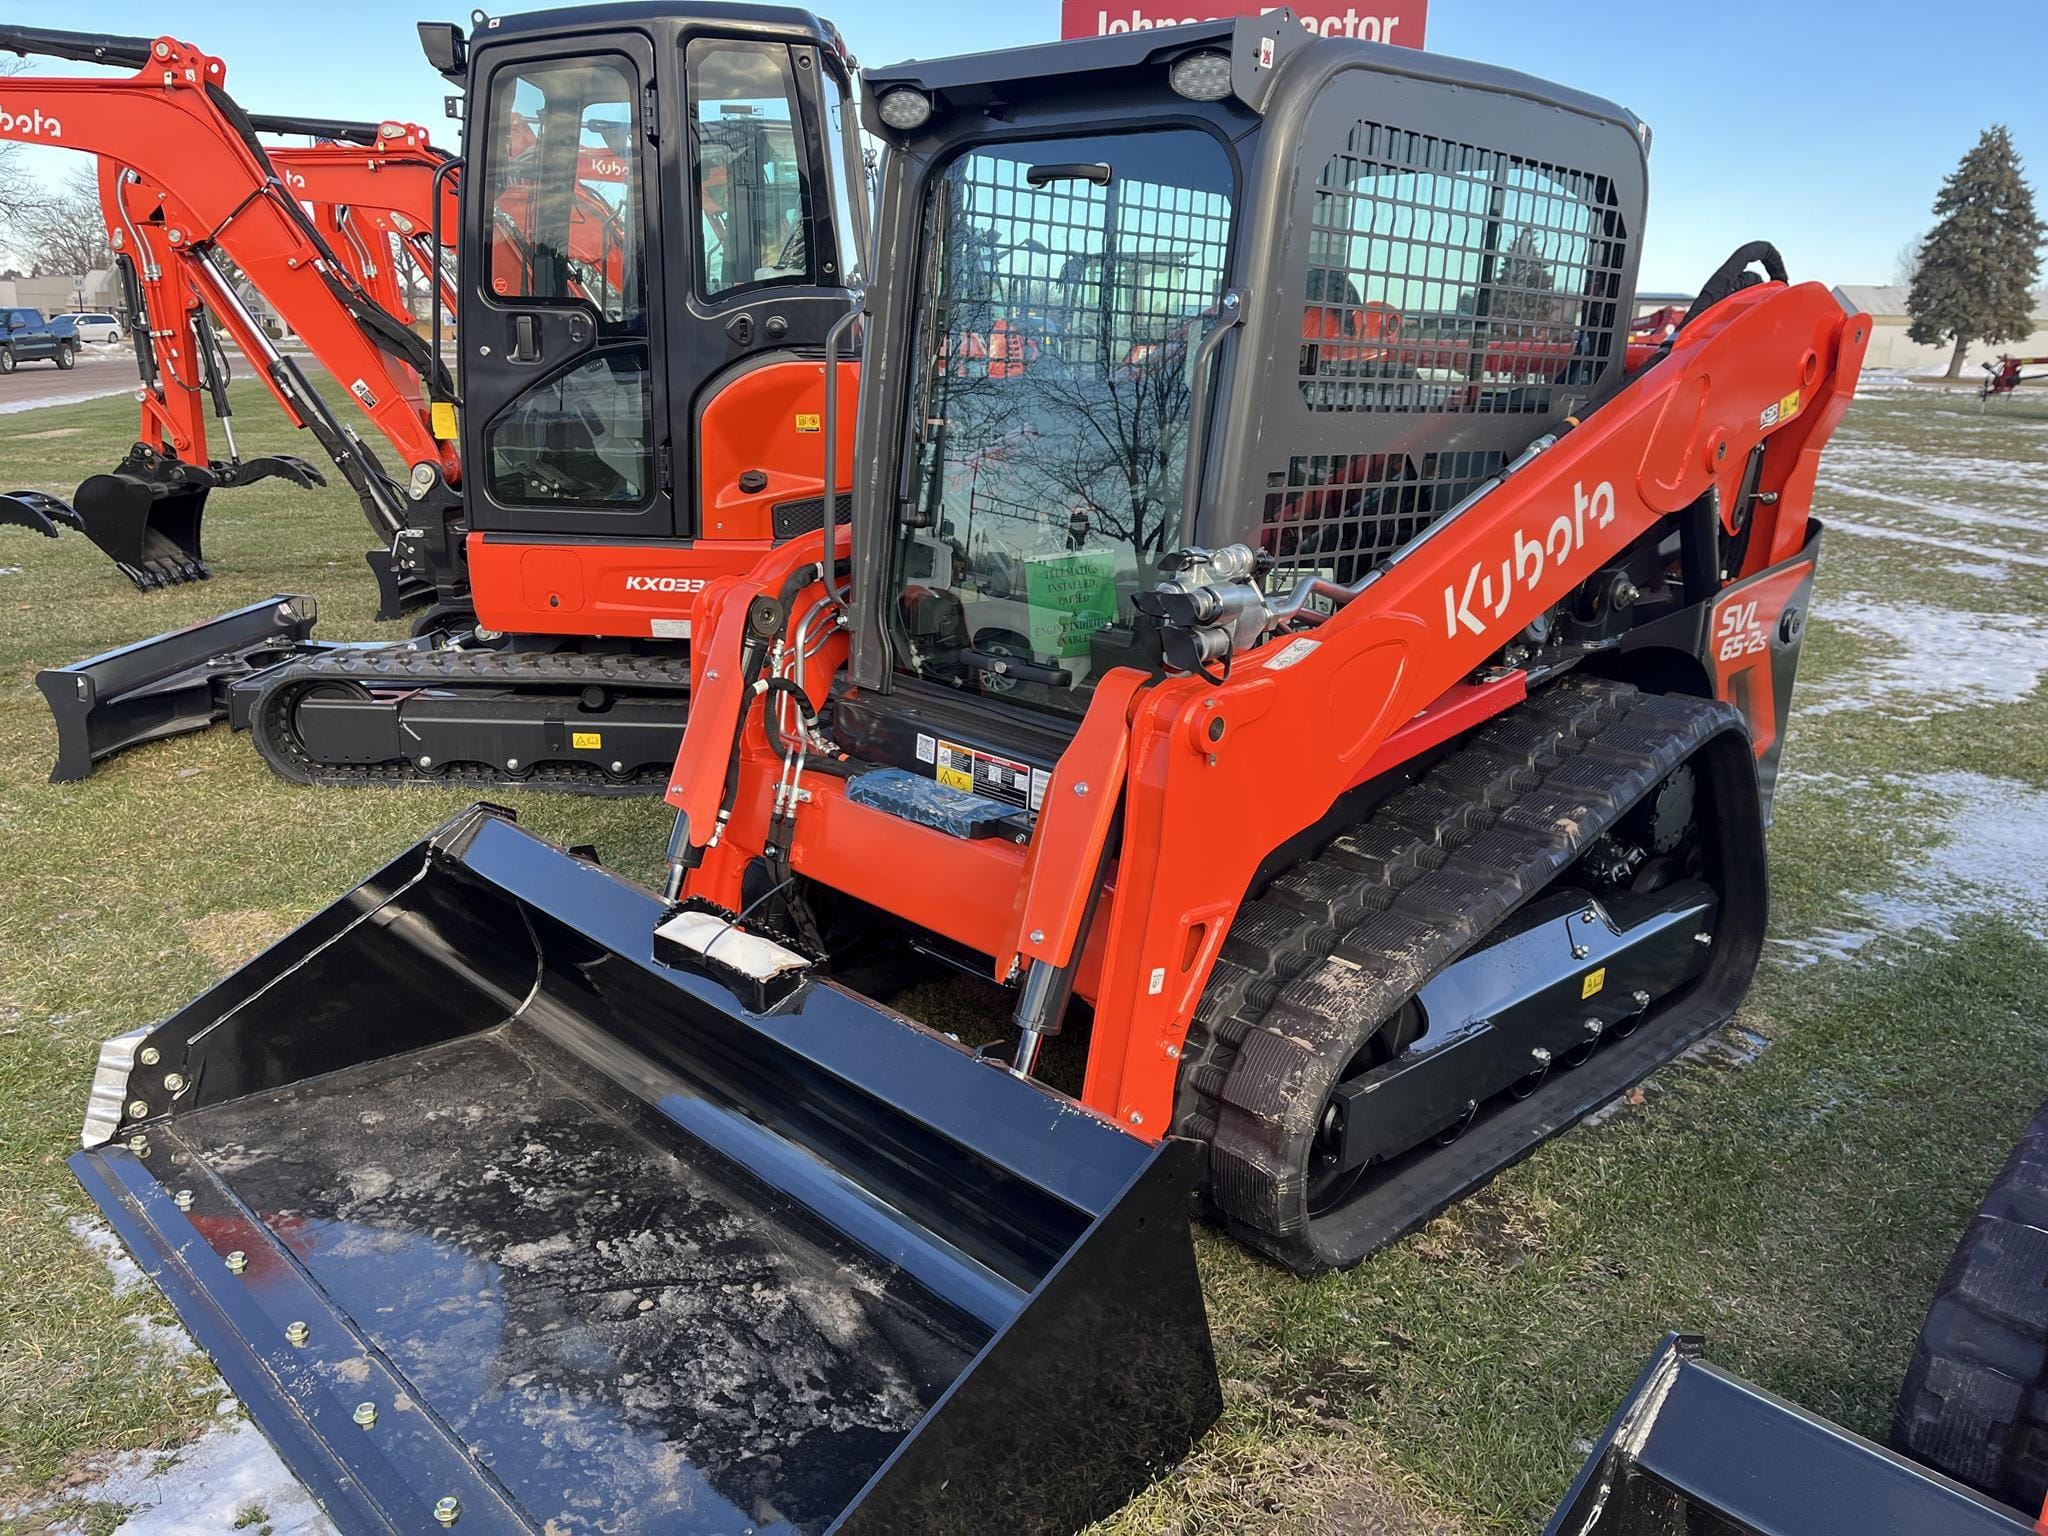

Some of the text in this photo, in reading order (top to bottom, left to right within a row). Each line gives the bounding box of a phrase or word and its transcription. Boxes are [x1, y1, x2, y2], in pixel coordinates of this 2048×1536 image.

[1444, 480, 1616, 640] Kubota
[1058, 593, 1090, 606] PAIRED
[1717, 600, 1761, 638] SVL
